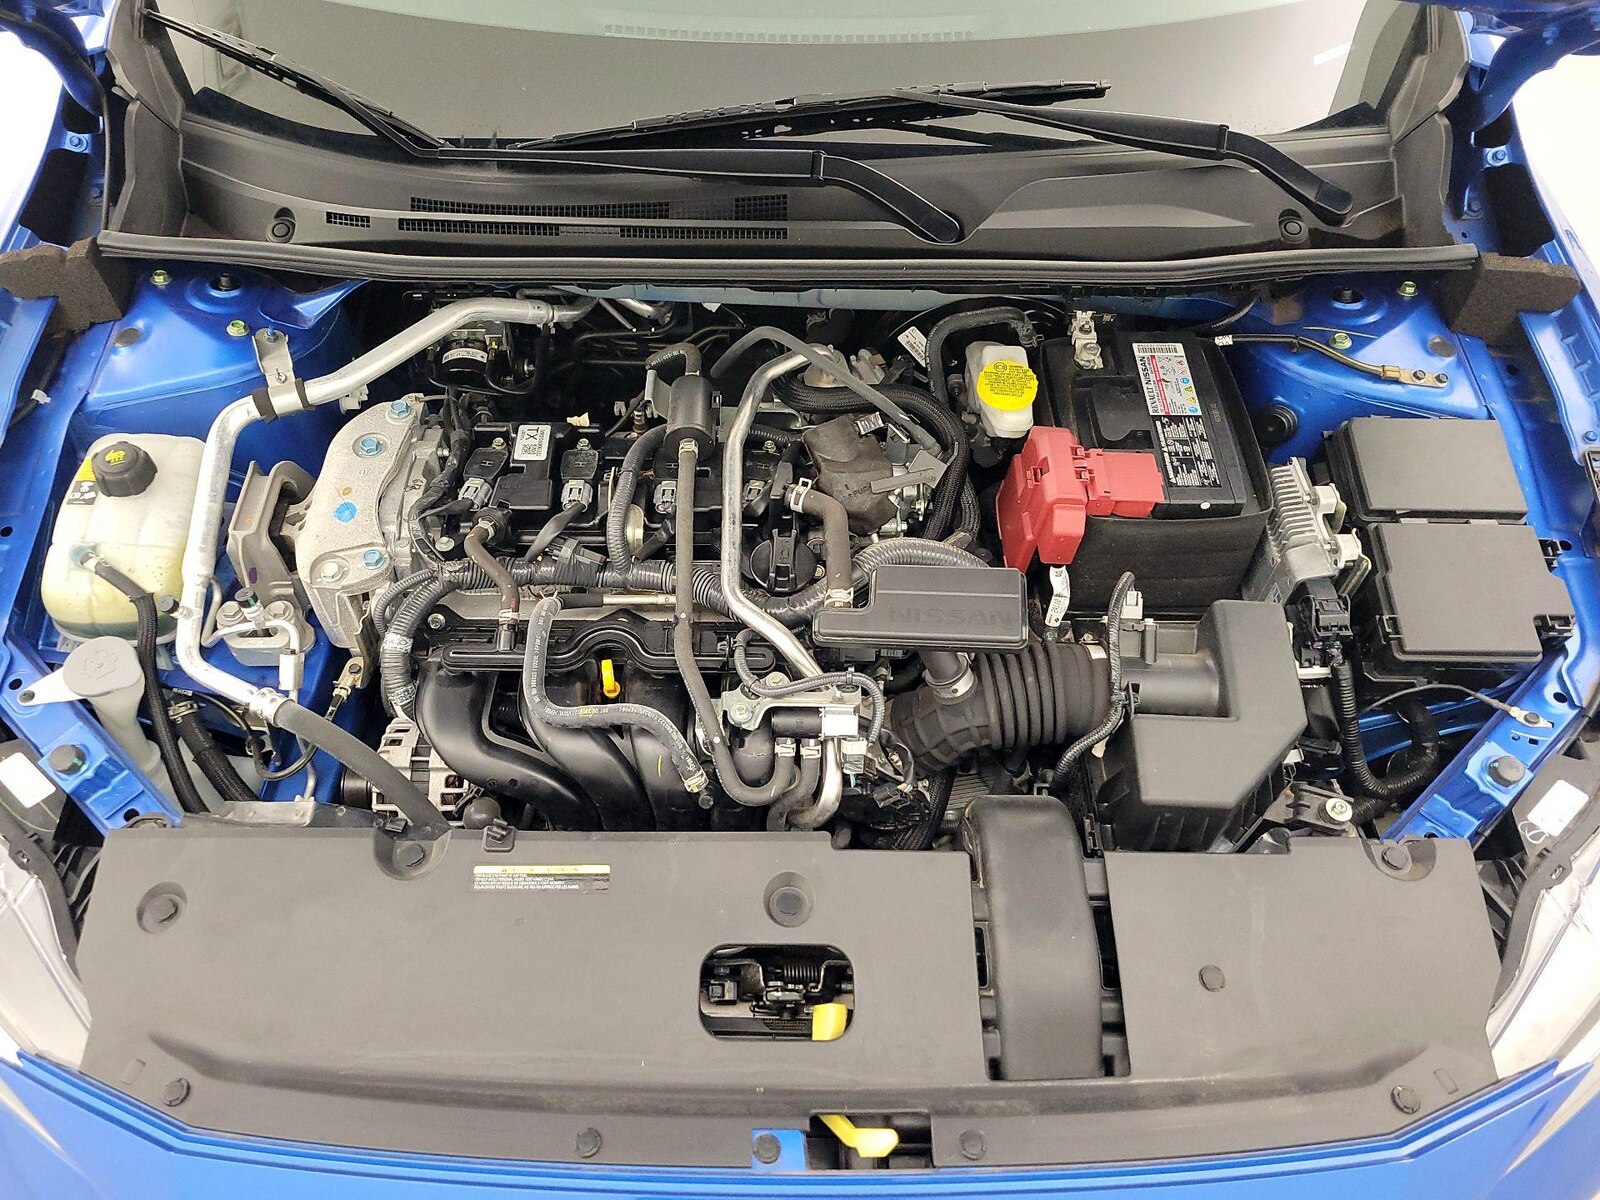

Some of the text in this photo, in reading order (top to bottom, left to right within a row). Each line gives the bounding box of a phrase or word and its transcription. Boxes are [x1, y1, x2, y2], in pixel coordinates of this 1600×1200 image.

[1139, 356, 1152, 385] NISSAN
[526, 426, 540, 441] TX
[889, 606, 1013, 625] NISSAN
